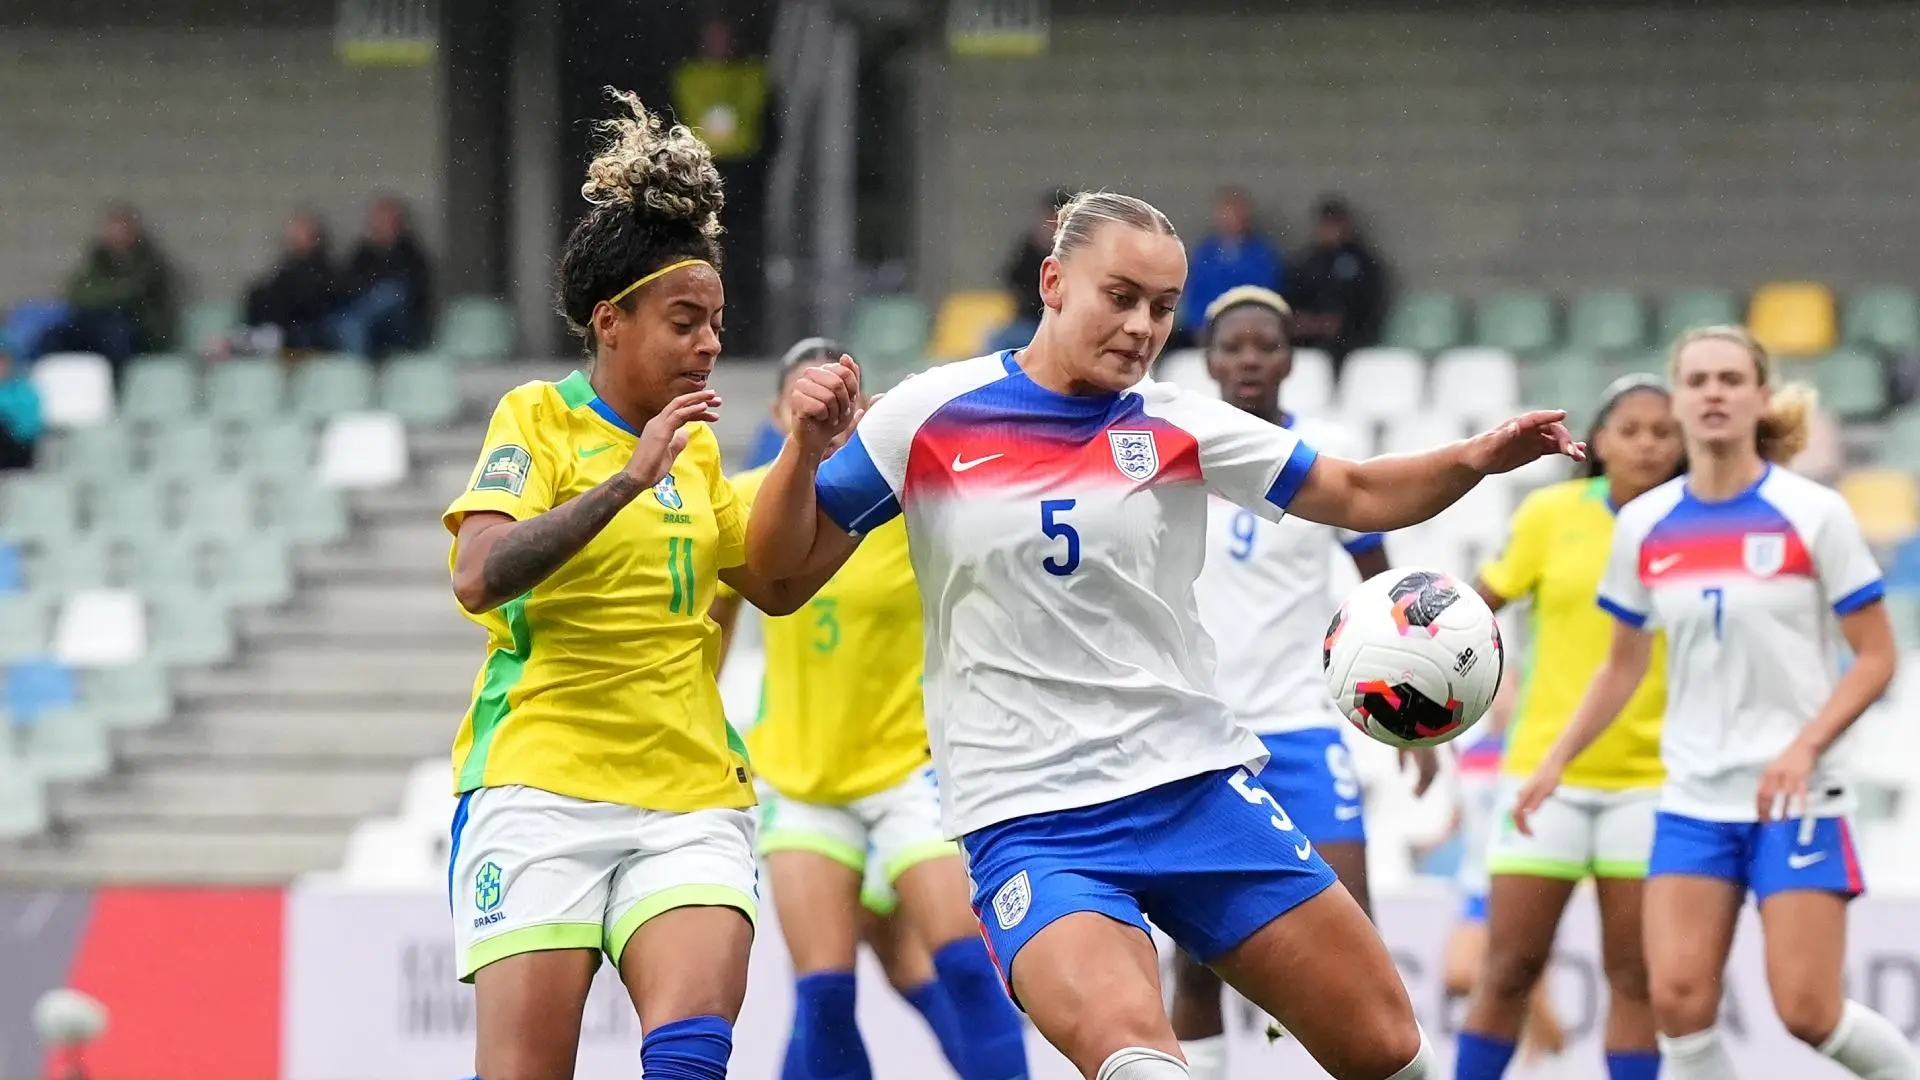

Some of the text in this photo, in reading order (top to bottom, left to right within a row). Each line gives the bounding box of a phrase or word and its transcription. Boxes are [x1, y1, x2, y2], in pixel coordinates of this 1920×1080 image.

[663, 513, 692, 524] BRASIL
[1041, 499, 1080, 576] 5
[1229, 509, 1257, 562] 9
[668, 537, 695, 616] 11
[813, 598, 842, 654] 3
[1702, 587, 1723, 643] 7
[1227, 768, 1294, 831] 5
[1324, 743, 1359, 800] 9
[474, 912, 507, 928] BRASIL
